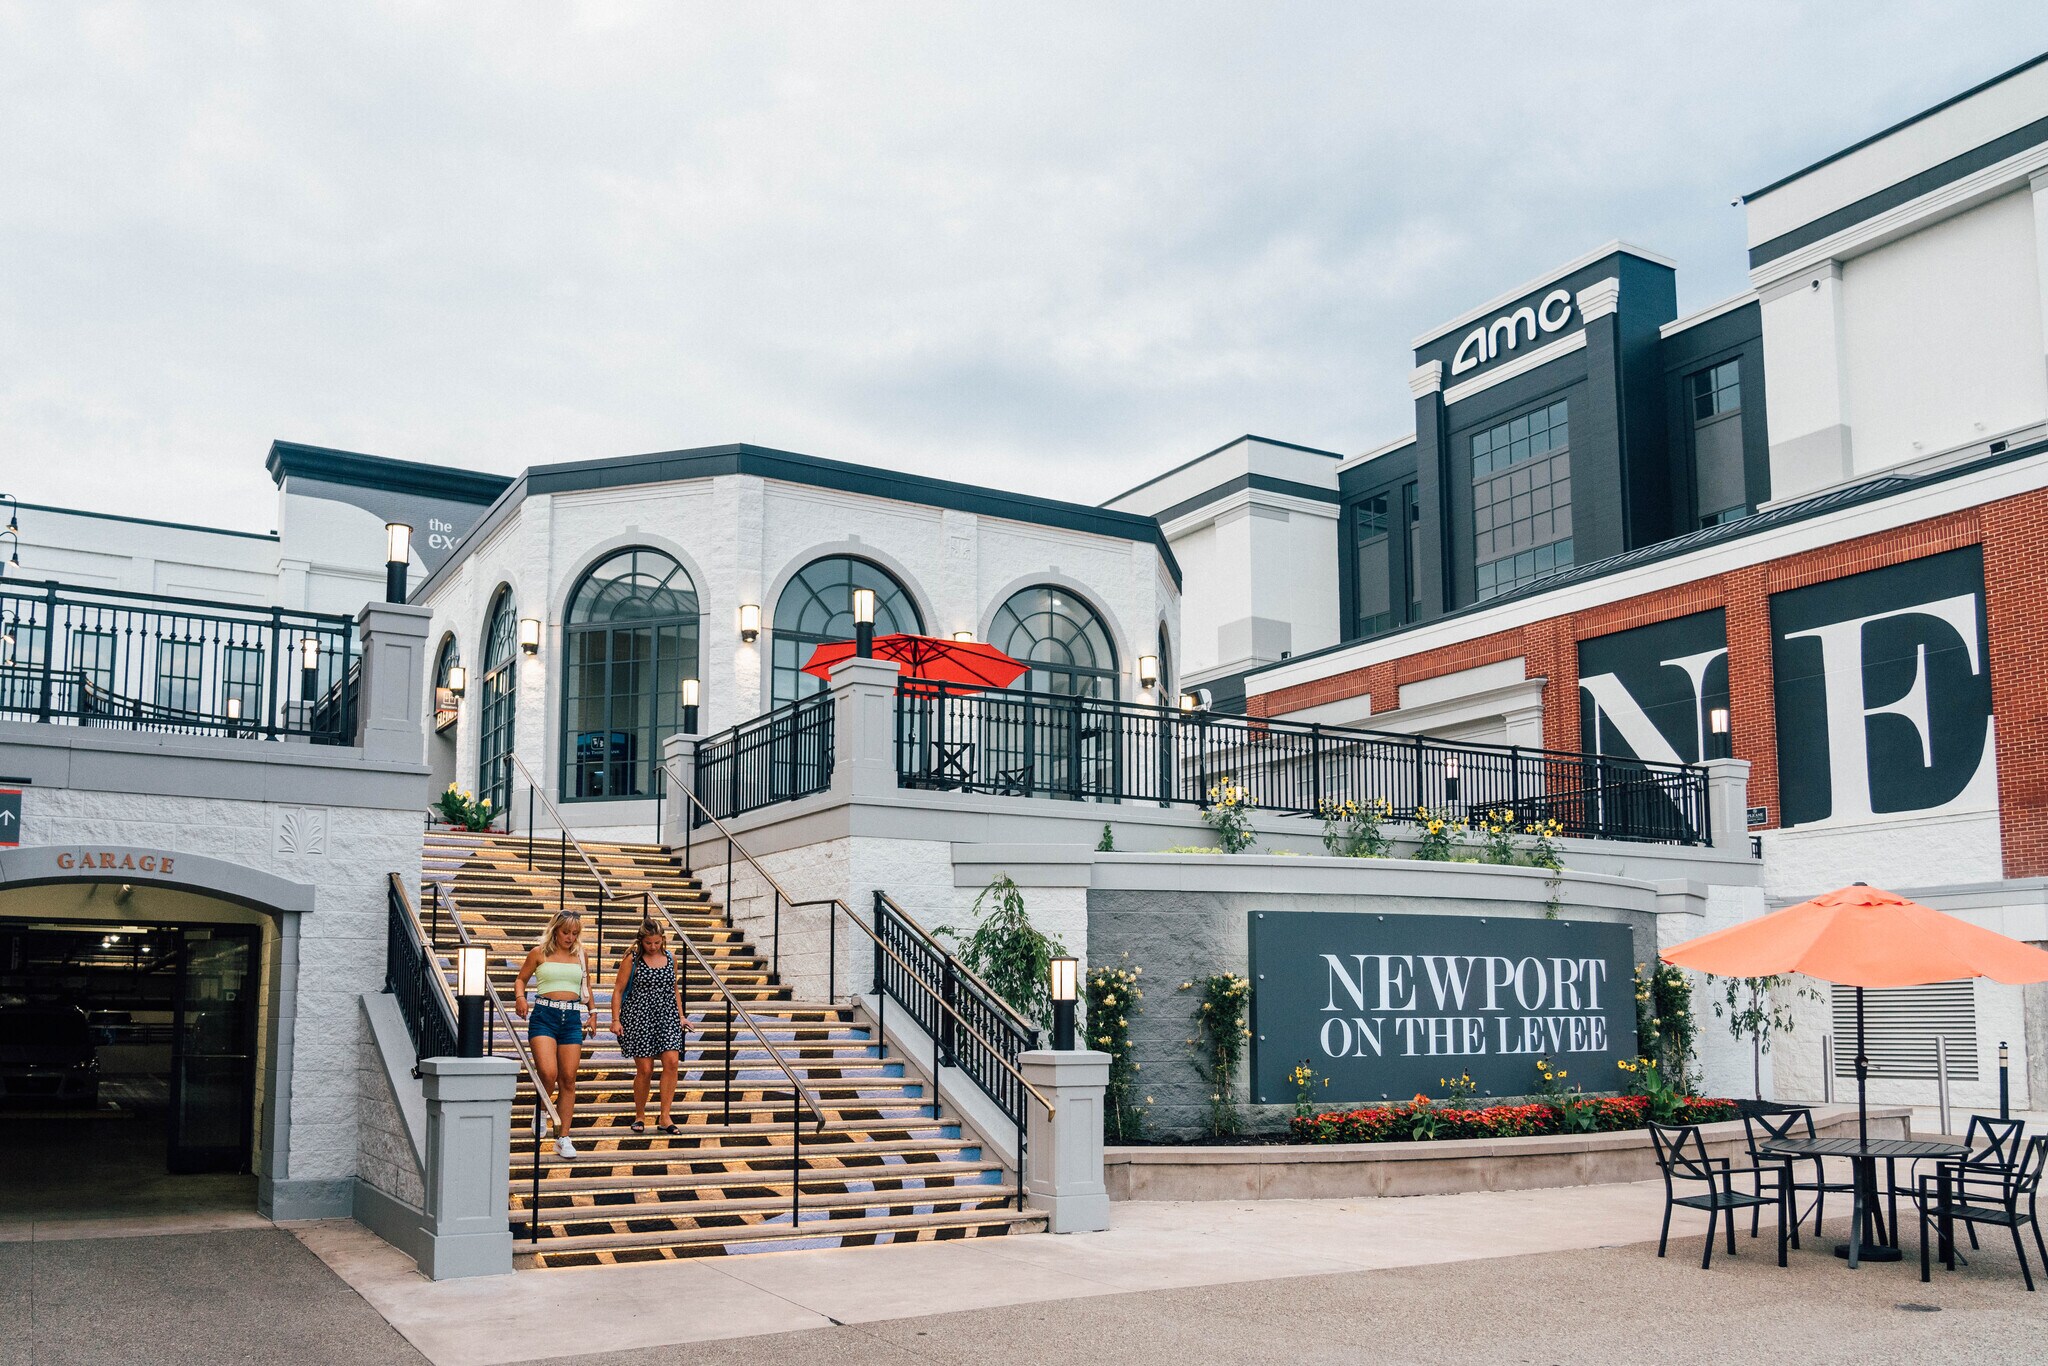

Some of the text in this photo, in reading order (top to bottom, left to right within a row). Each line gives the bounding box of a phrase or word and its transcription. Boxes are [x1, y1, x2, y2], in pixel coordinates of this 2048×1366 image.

[429, 518, 453, 533] the
[428, 534, 462, 550] ex
[57, 852, 175, 875] GARAGE
[1319, 953, 1607, 1012] NEWPORT
[1320, 1016, 1608, 1059] ON THE LEVEE
